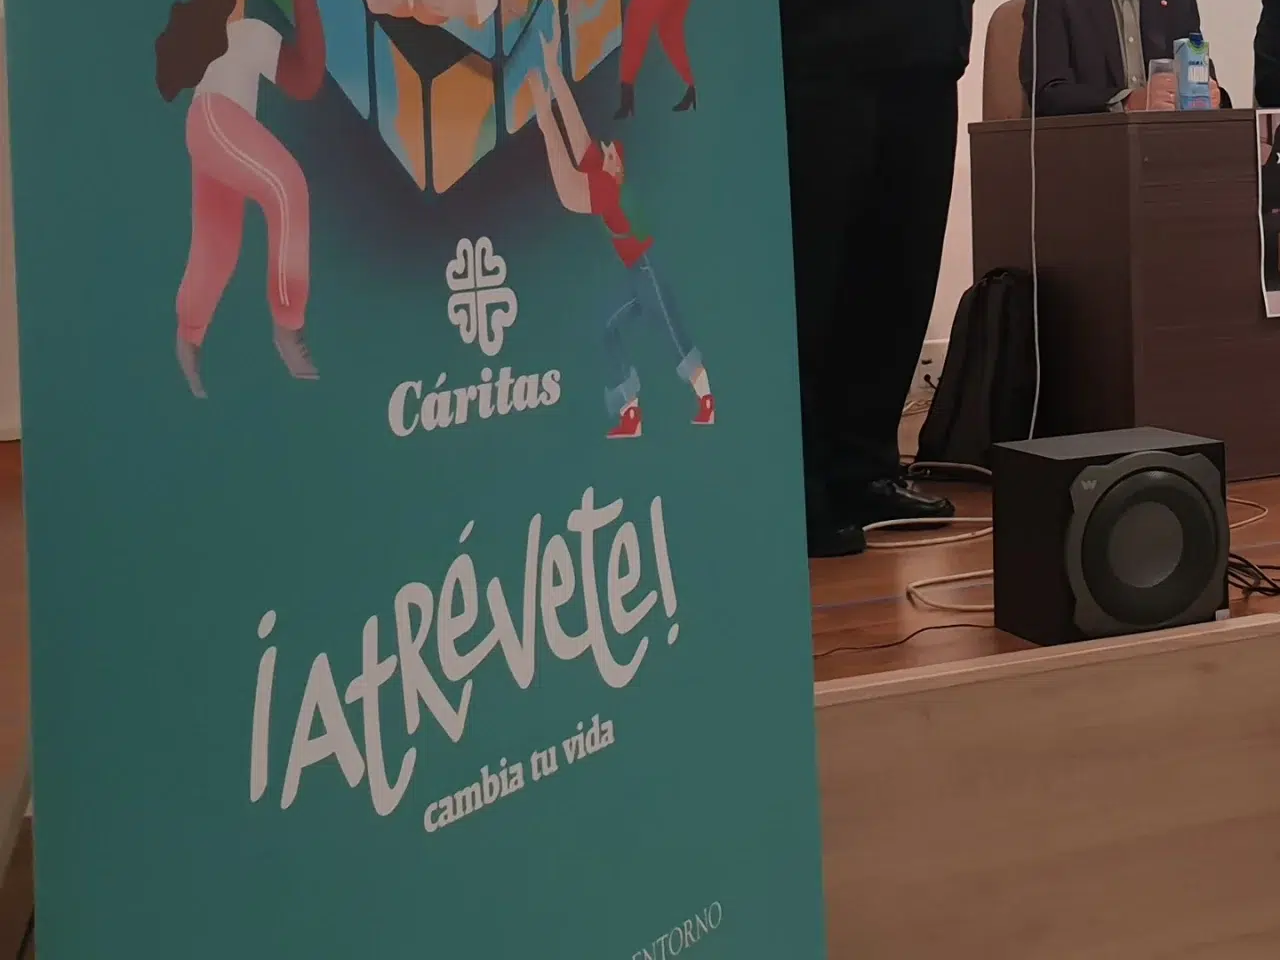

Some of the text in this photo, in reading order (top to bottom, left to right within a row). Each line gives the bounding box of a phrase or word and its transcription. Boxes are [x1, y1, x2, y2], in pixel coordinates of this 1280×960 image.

[388, 367, 561, 437] Cáritas
[424, 713, 615, 832] cambia tu vida
